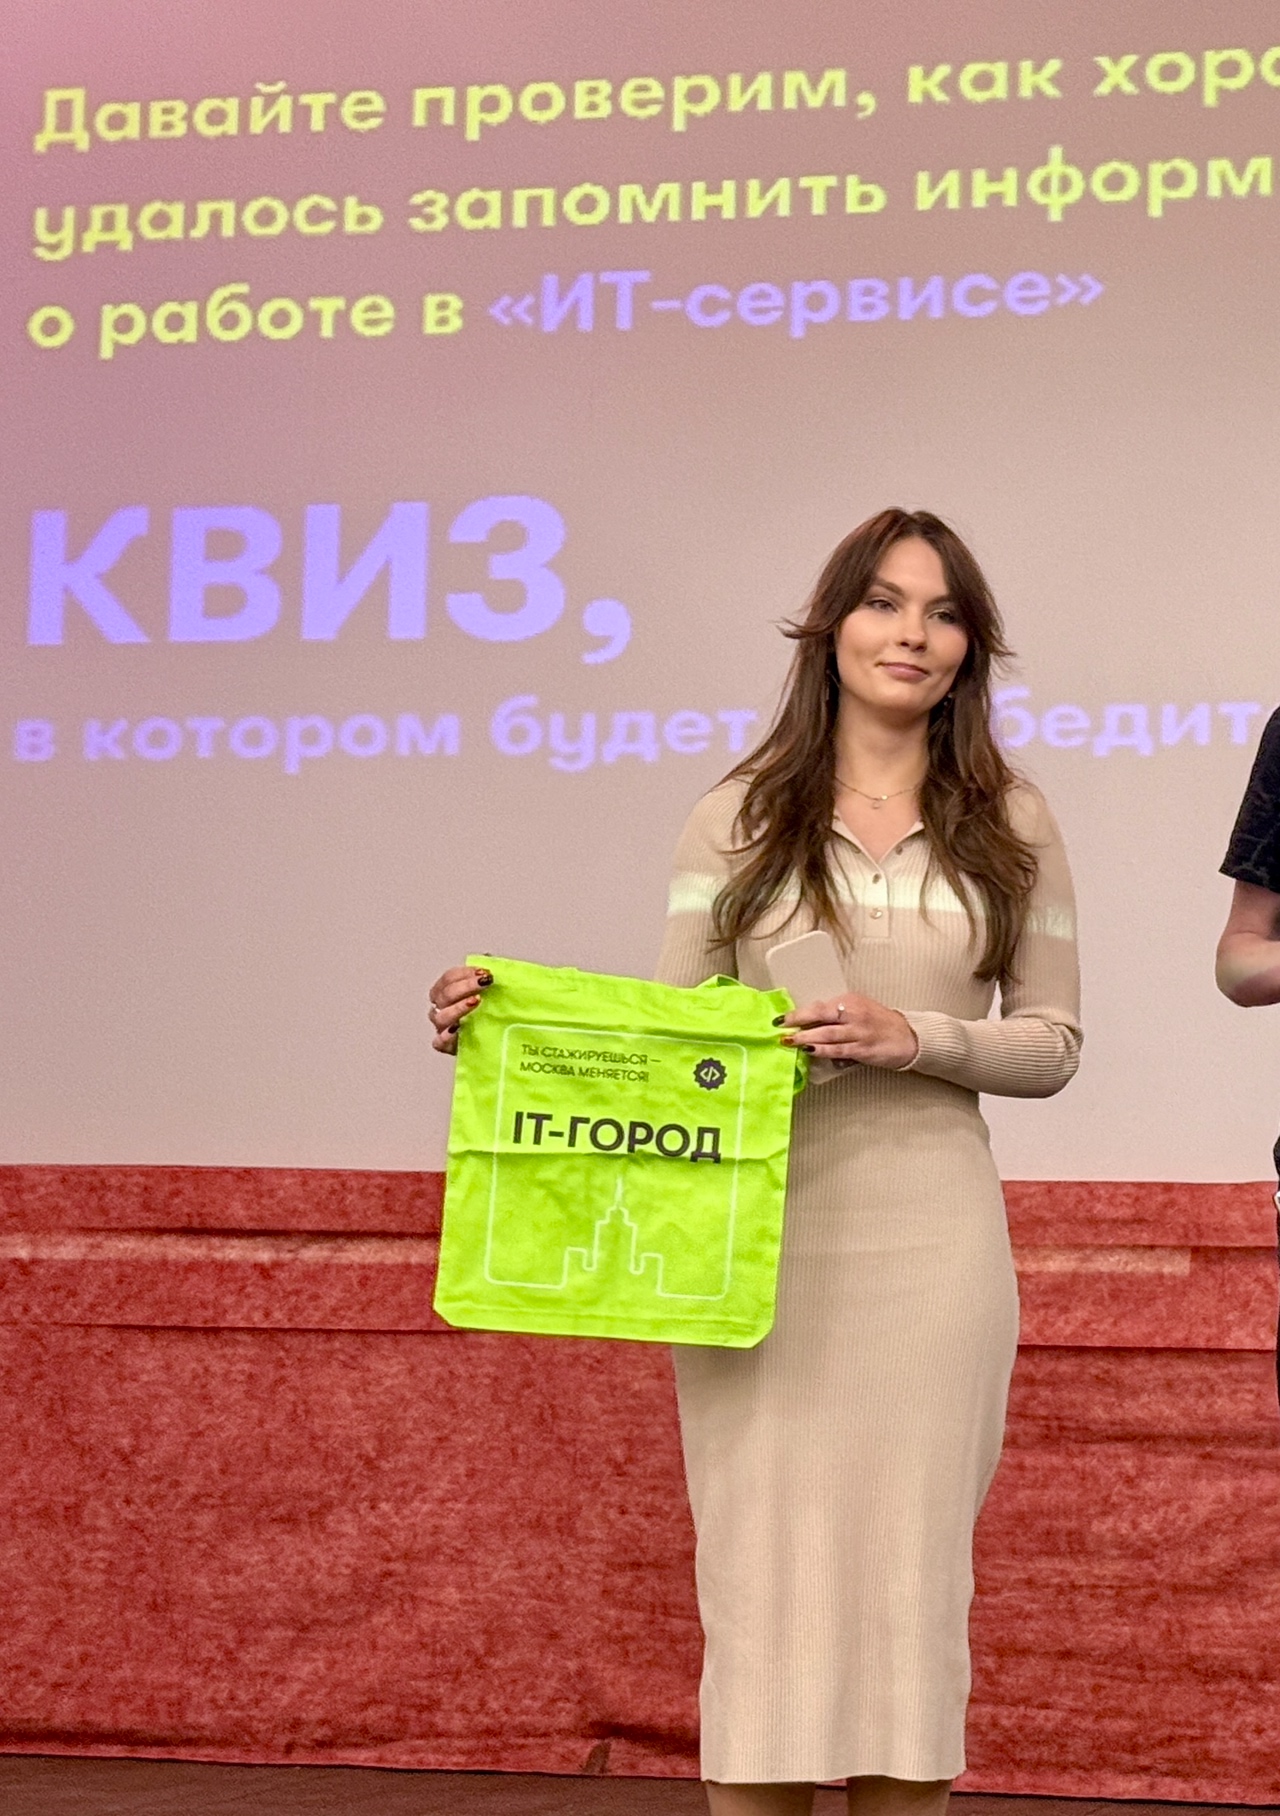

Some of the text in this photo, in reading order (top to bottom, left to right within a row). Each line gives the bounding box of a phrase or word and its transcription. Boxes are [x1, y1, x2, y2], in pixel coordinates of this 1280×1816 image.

[34, 82, 385, 153] Давайте
[412, 68, 877, 141] проверим,
[908, 59, 1062, 104] как
[33, 194, 385, 262] удалось
[409, 175, 887, 232] запомнить
[27, 269, 1105, 360] о работе в «ИТ-сервисе»
[27, 494, 632, 665] КВИЗ,
[14, 686, 1262, 775] в котором будет бедит
[520, 1061, 650, 1082] МОСКВА МЕНЯЕТСЯ!
[522, 1044, 541, 1056] ТЫ
[542, 1046, 648, 1065] СТАЖИРУЕШЬСЯ
[513, 1111, 721, 1163] IT-ГОРОД
